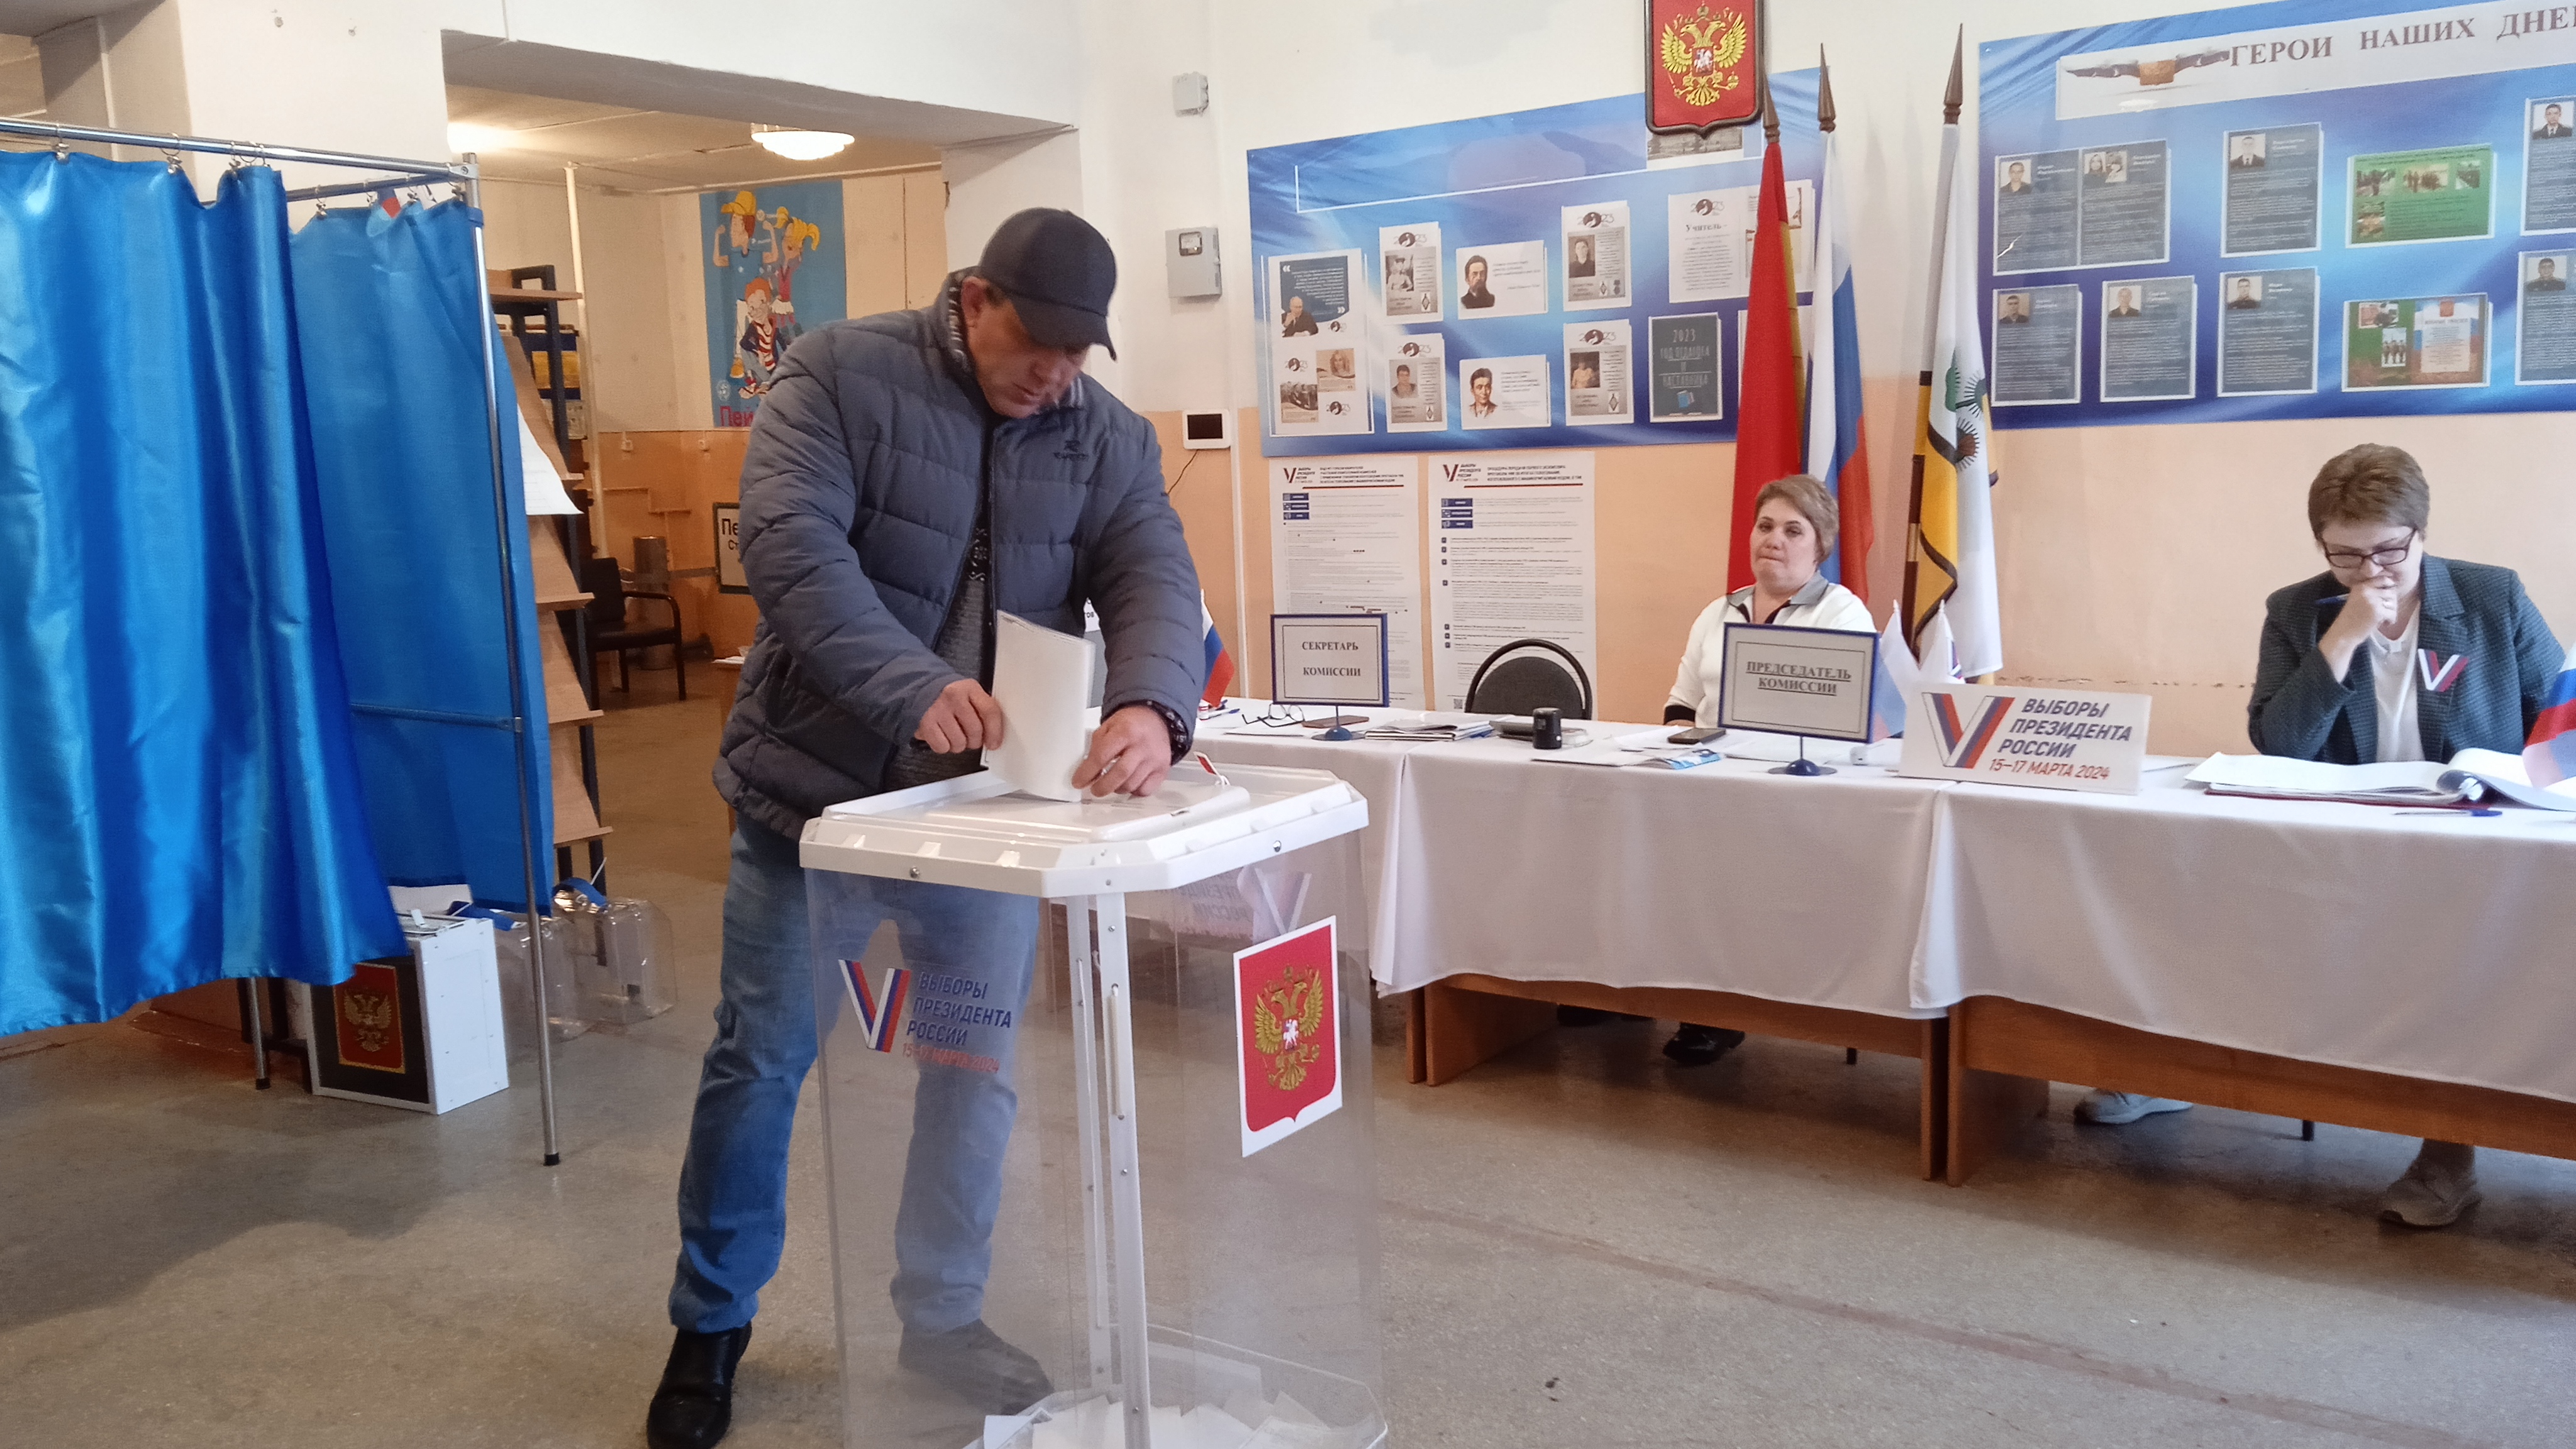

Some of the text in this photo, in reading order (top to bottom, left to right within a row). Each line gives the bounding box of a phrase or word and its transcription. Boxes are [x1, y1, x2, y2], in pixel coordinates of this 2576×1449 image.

[2230, 5, 2576, 67] ГЕРОИ НАШИХ ДНЕ
[1673, 328, 1696, 343] 2023
[1302, 641, 1358, 650] СЕКРЕТАРЬ
[1302, 667, 1361, 676] КОМИССИИ
[1746, 661, 1852, 680] ПРЕДСЕДАТЕЛЬ
[1758, 677, 1837, 694] КОМИССИИ
[2021, 698, 2109, 718] ВЫБОРЫ
[2009, 718, 2133, 741] ПРЕЗИДЕНТА
[1997, 738, 2077, 758] РОССИИ
[2026, 762, 2073, 777] МАРТА
[2075, 765, 2110, 780] 2024
[918, 972, 988, 999] ВЫБОРЫ
[913, 996, 1012, 1028] ПРЕЗИДЕНТА
[906, 1020, 968, 1046] РОССИИ
